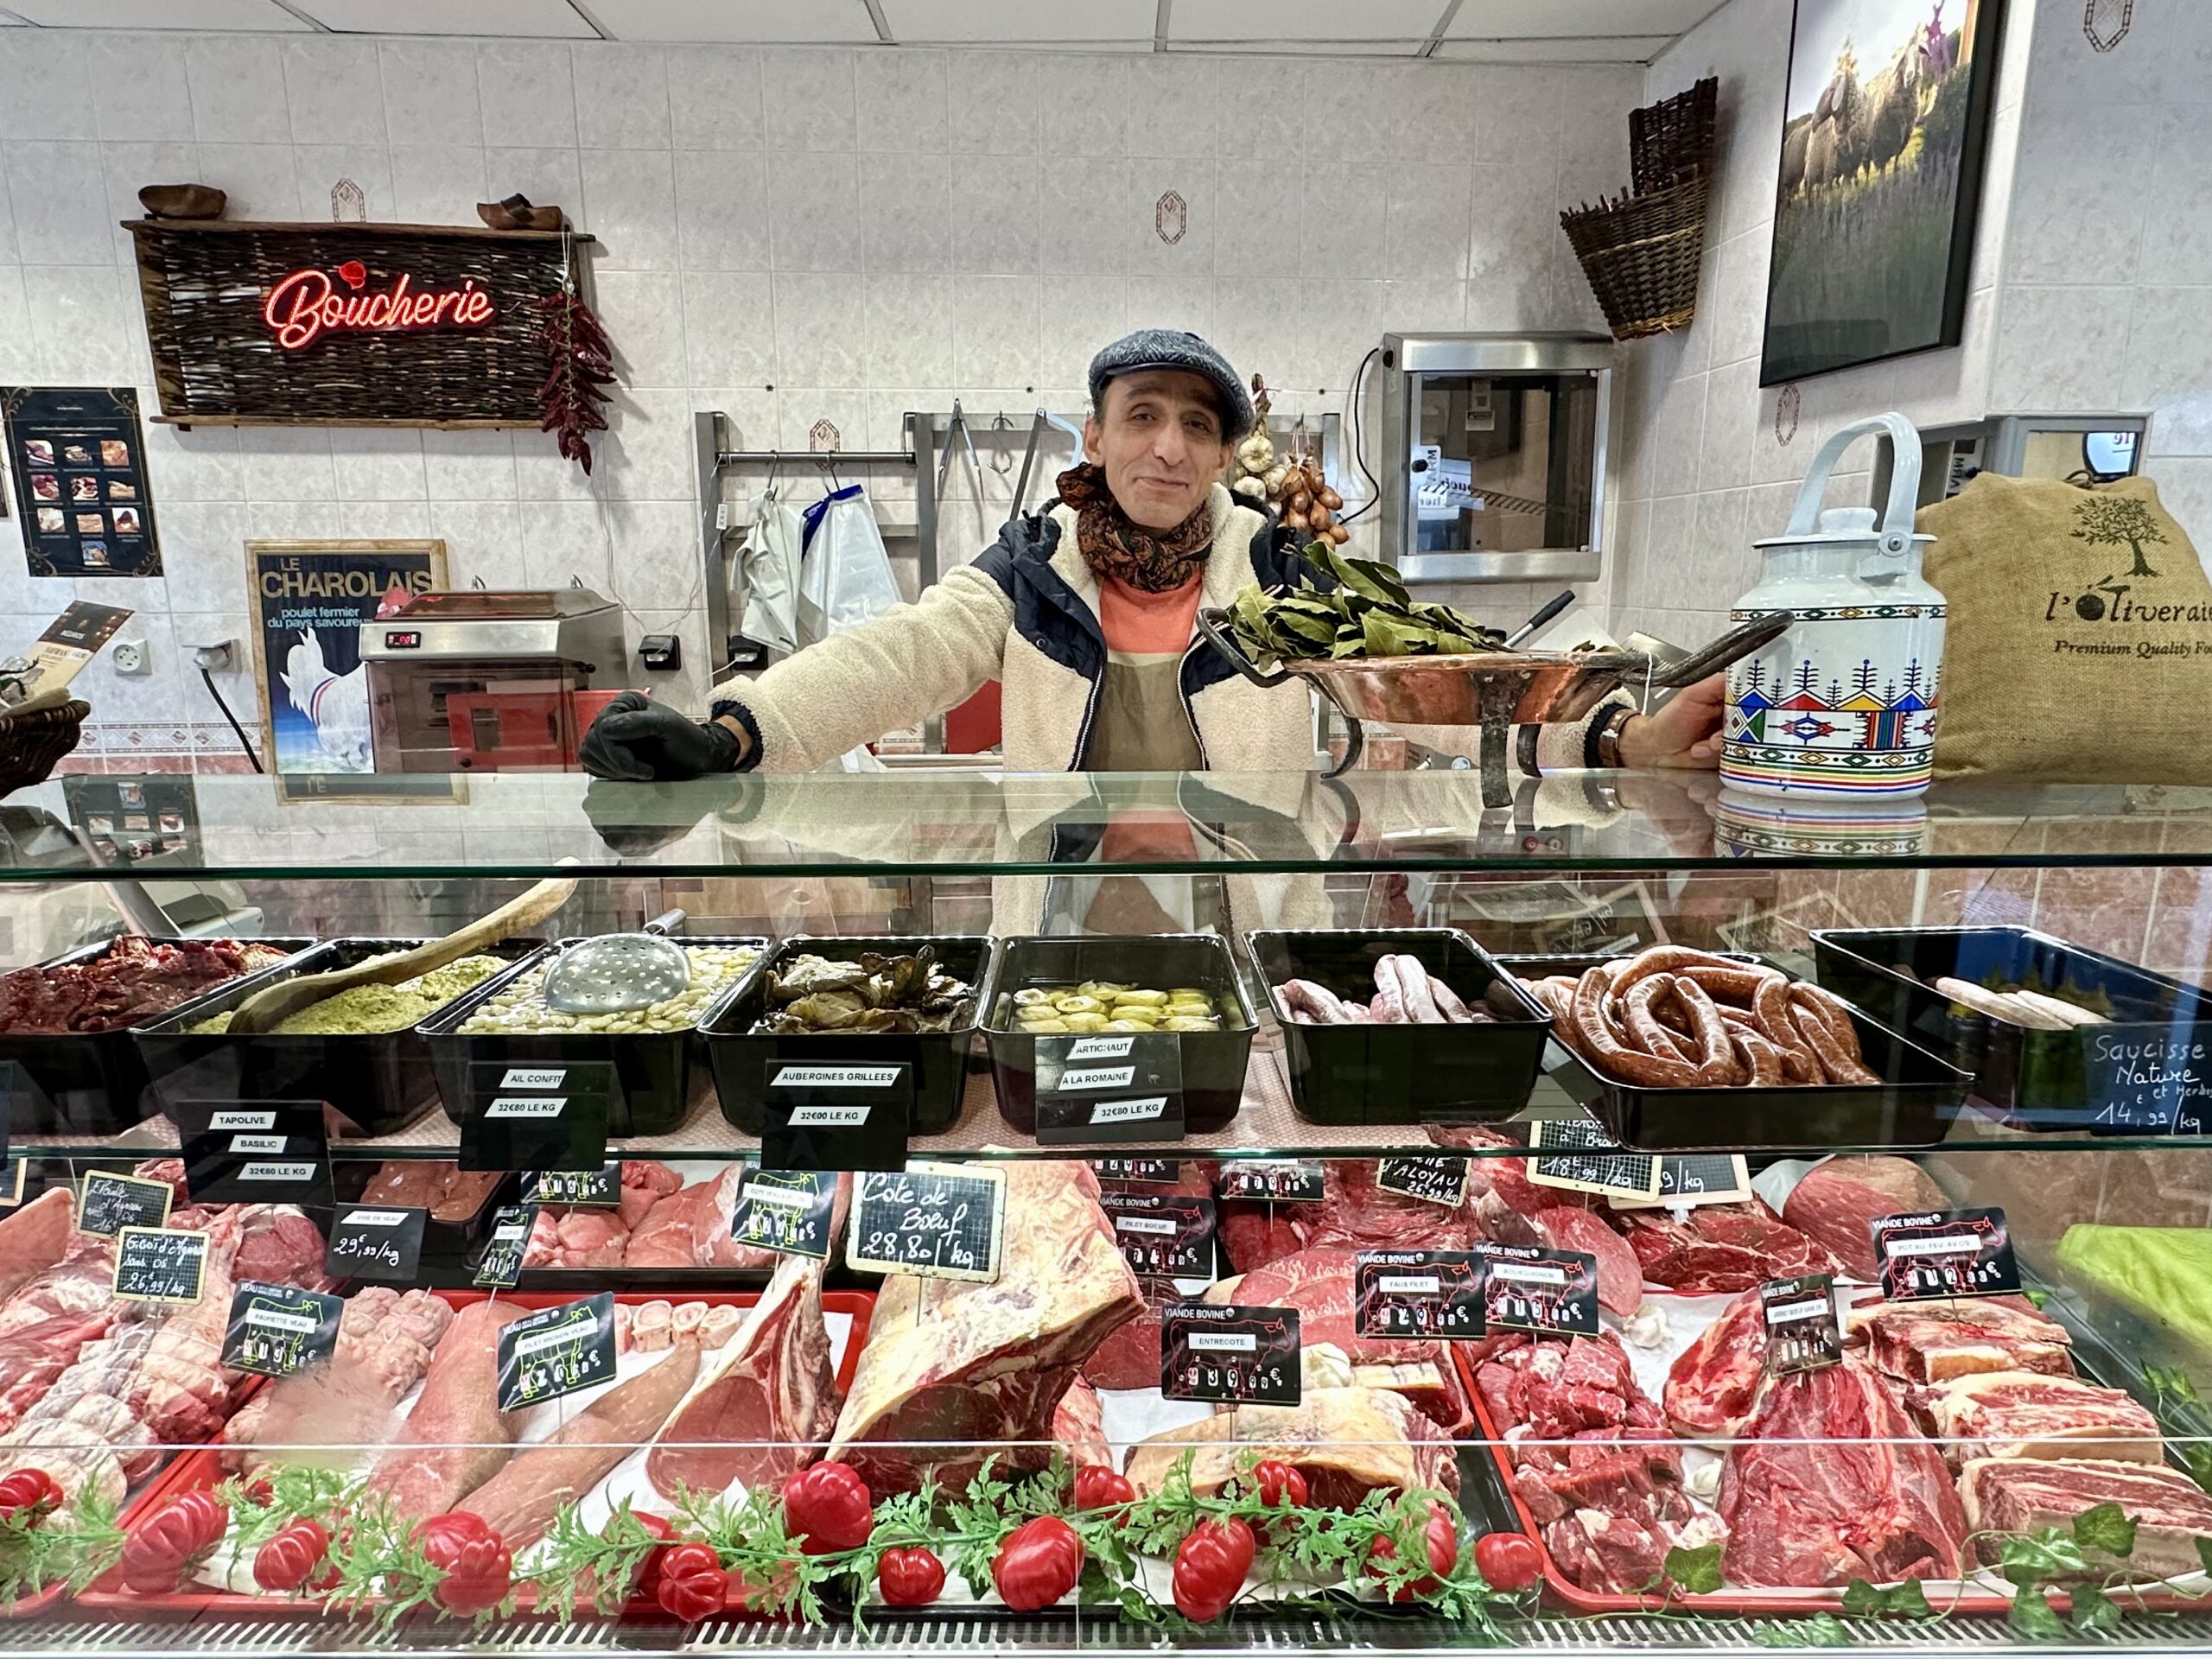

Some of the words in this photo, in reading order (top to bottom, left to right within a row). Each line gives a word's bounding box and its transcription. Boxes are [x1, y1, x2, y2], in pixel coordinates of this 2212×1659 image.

[265, 270, 493, 349] Boucherie
[281, 557, 300, 571] LE
[261, 571, 432, 599] CHAROLAIS
[282, 607, 317, 620] poulet
[319, 606, 359, 618] fermier
[268, 618, 283, 628] du
[286, 620, 313, 632] pays
[2054, 640, 2132, 657] Premium
[2137, 640, 2191, 659] Quality
[2094, 1034, 2205, 1062] Saucisse
[847, 1072, 893, 1081] GRILLEES
[1071, 1075, 1084, 1084] LA
[1085, 1071, 1128, 1084] ROMAINE
[2116, 1060, 2200, 1085] Nature
[1131, 1105, 1142, 1114] LE
[1146, 1103, 1160, 1112] KG
[920, 1182, 949, 1205] de
[1126, 1198, 1152, 1207] BOVINE
[1872, 1217, 1903, 1229] VIANDE
[1904, 1216, 1934, 1226] BOVINE
[1476, 1244, 1503, 1255] VIANDE
[1504, 1247, 1531, 1258] BOVINE
[1357, 1254, 1386, 1264] VIANDE
[1387, 1255, 1415, 1264] BOVINE
[1165, 1308, 1194, 1318] VIANDE
[1197, 1309, 1226, 1319] BOVINE
